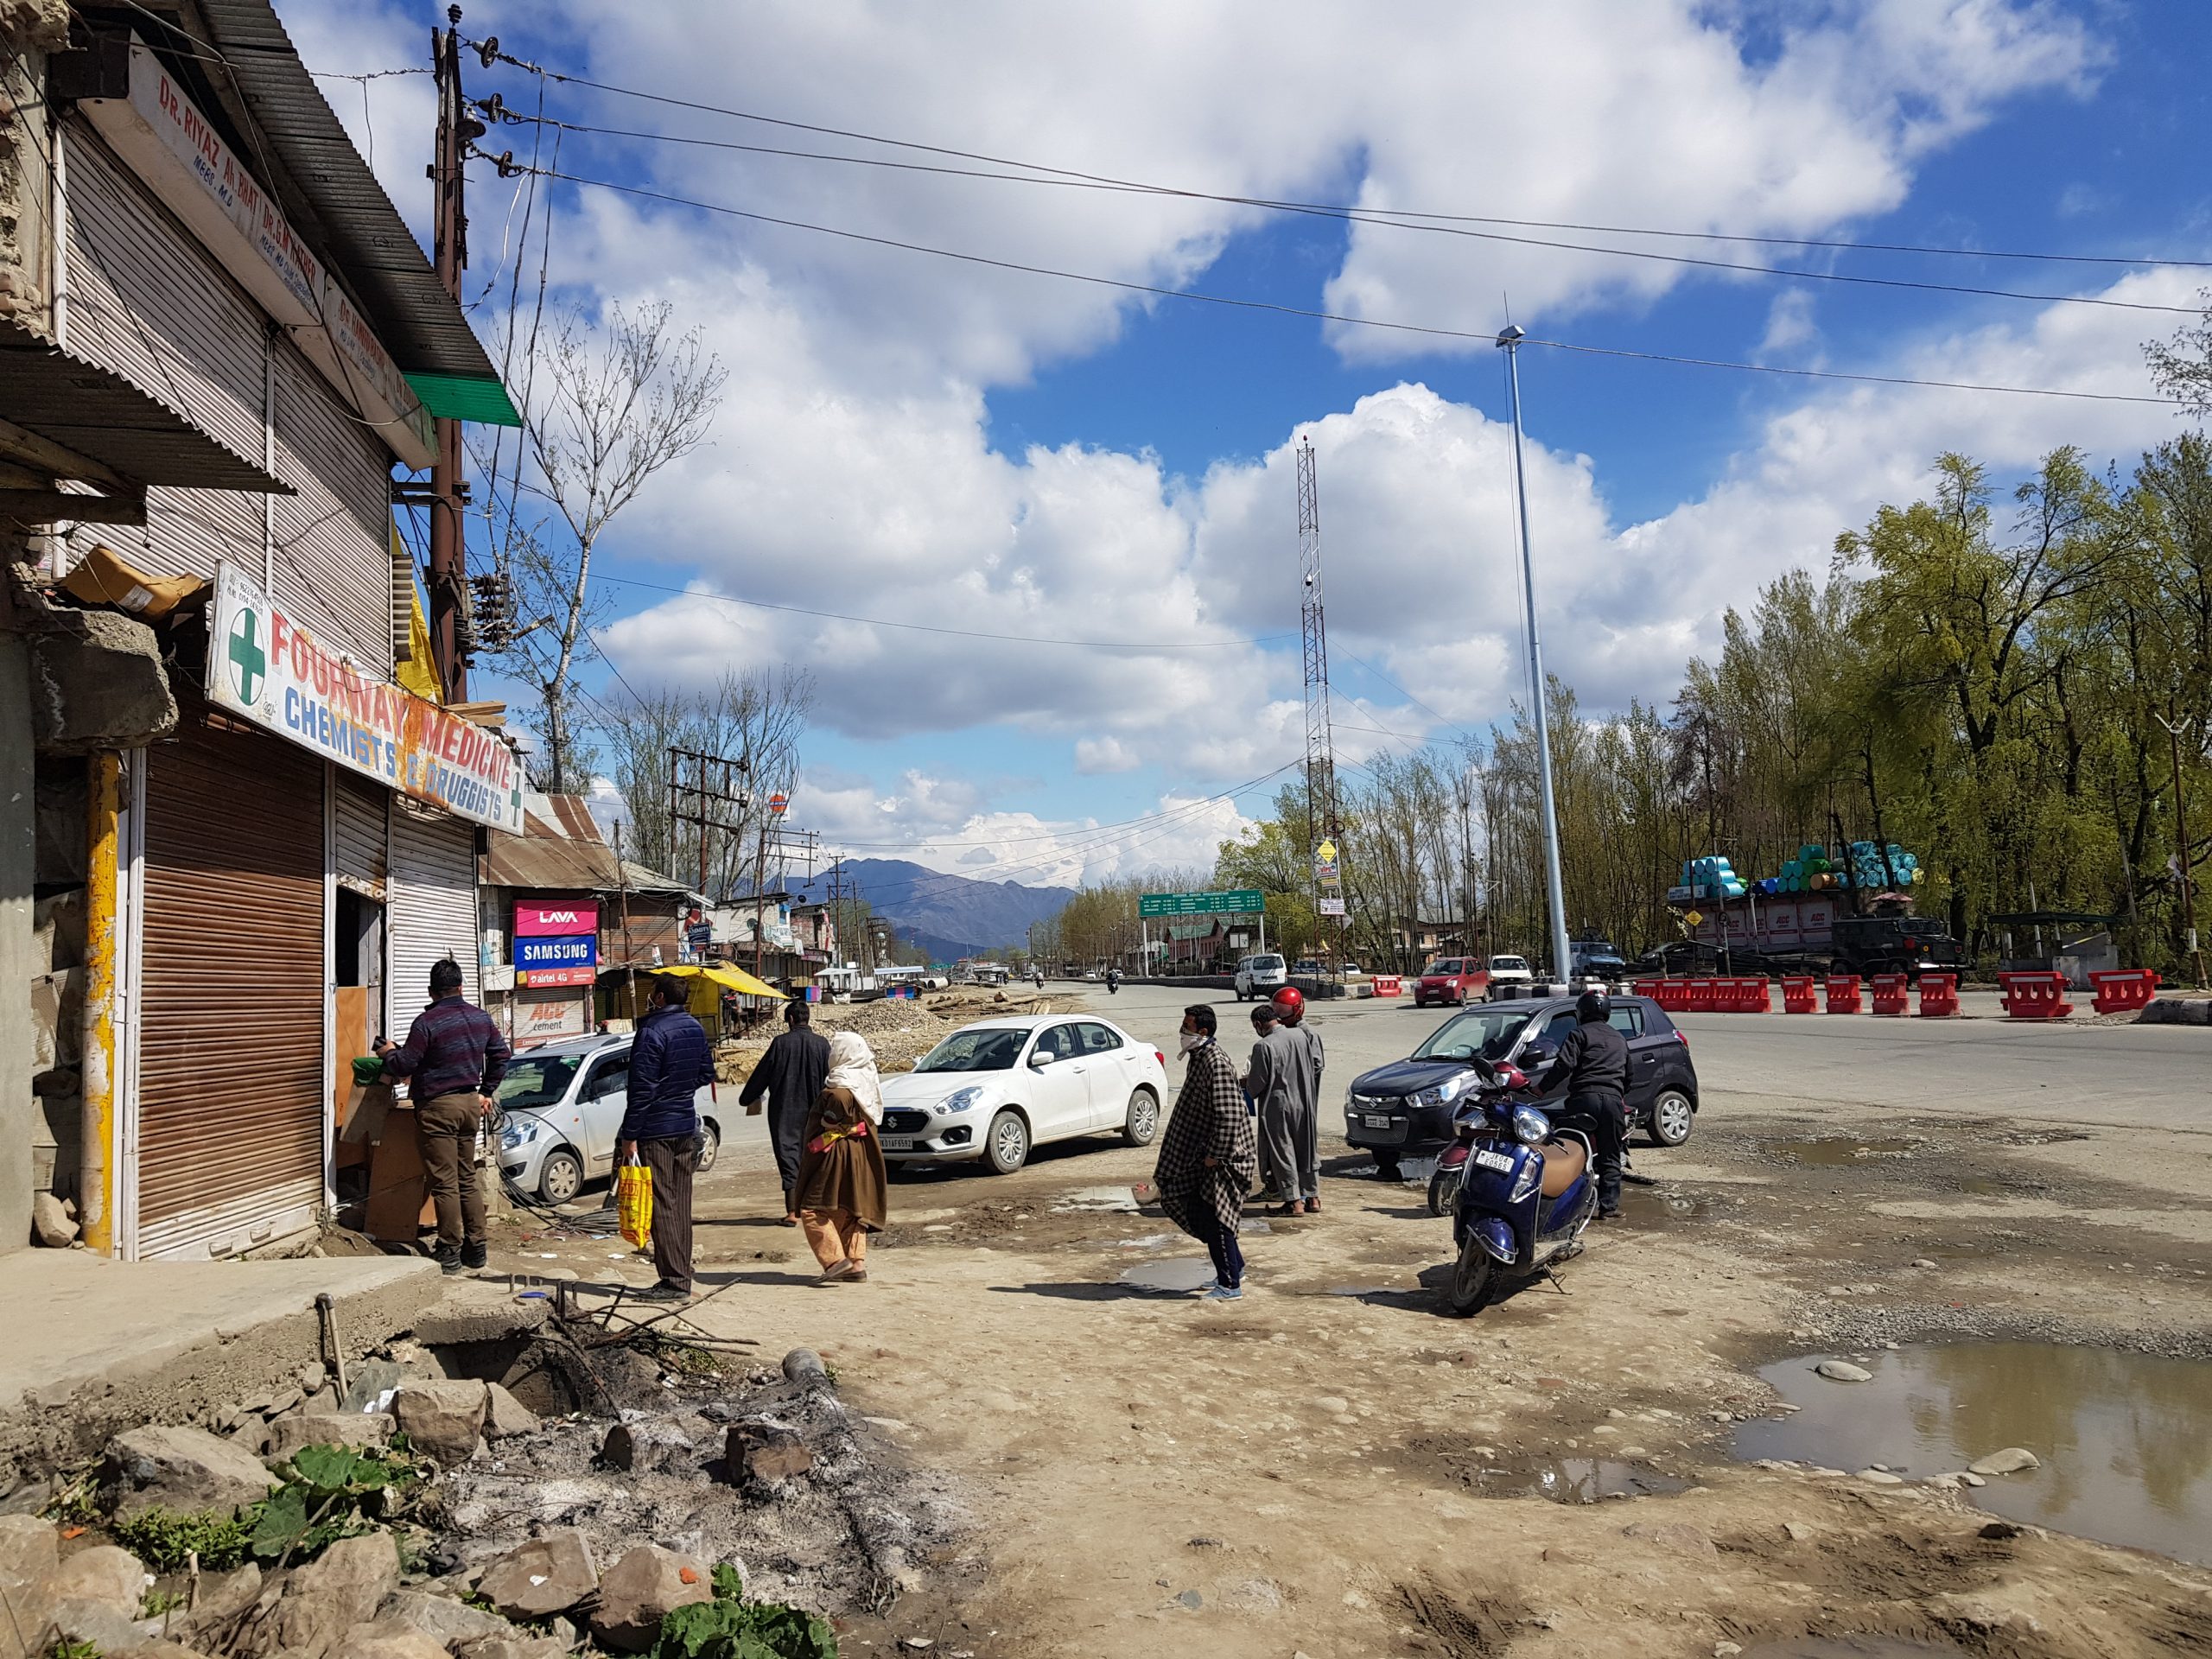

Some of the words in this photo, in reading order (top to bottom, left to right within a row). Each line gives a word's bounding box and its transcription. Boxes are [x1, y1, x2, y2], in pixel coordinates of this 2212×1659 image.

[159, 75, 181, 126] DR.
[184, 105, 220, 168] RIYAZ
[271, 608, 409, 745] FOURWAY
[420, 707, 511, 790] MEDICATE
[285, 686, 396, 778] CHEMISTS
[426, 763, 501, 821] DRUGGISTS
[539, 912, 578, 923] LAVA
[1777, 916, 1789, 925] ACC
[1810, 913, 1825, 922] ACC
[524, 944, 588, 960] SAMSUNG
[537, 974, 555, 983] airtel
[557, 973, 568, 982] 4G
[530, 1001, 567, 1020] ACC
[533, 1022, 562, 1031] cement
